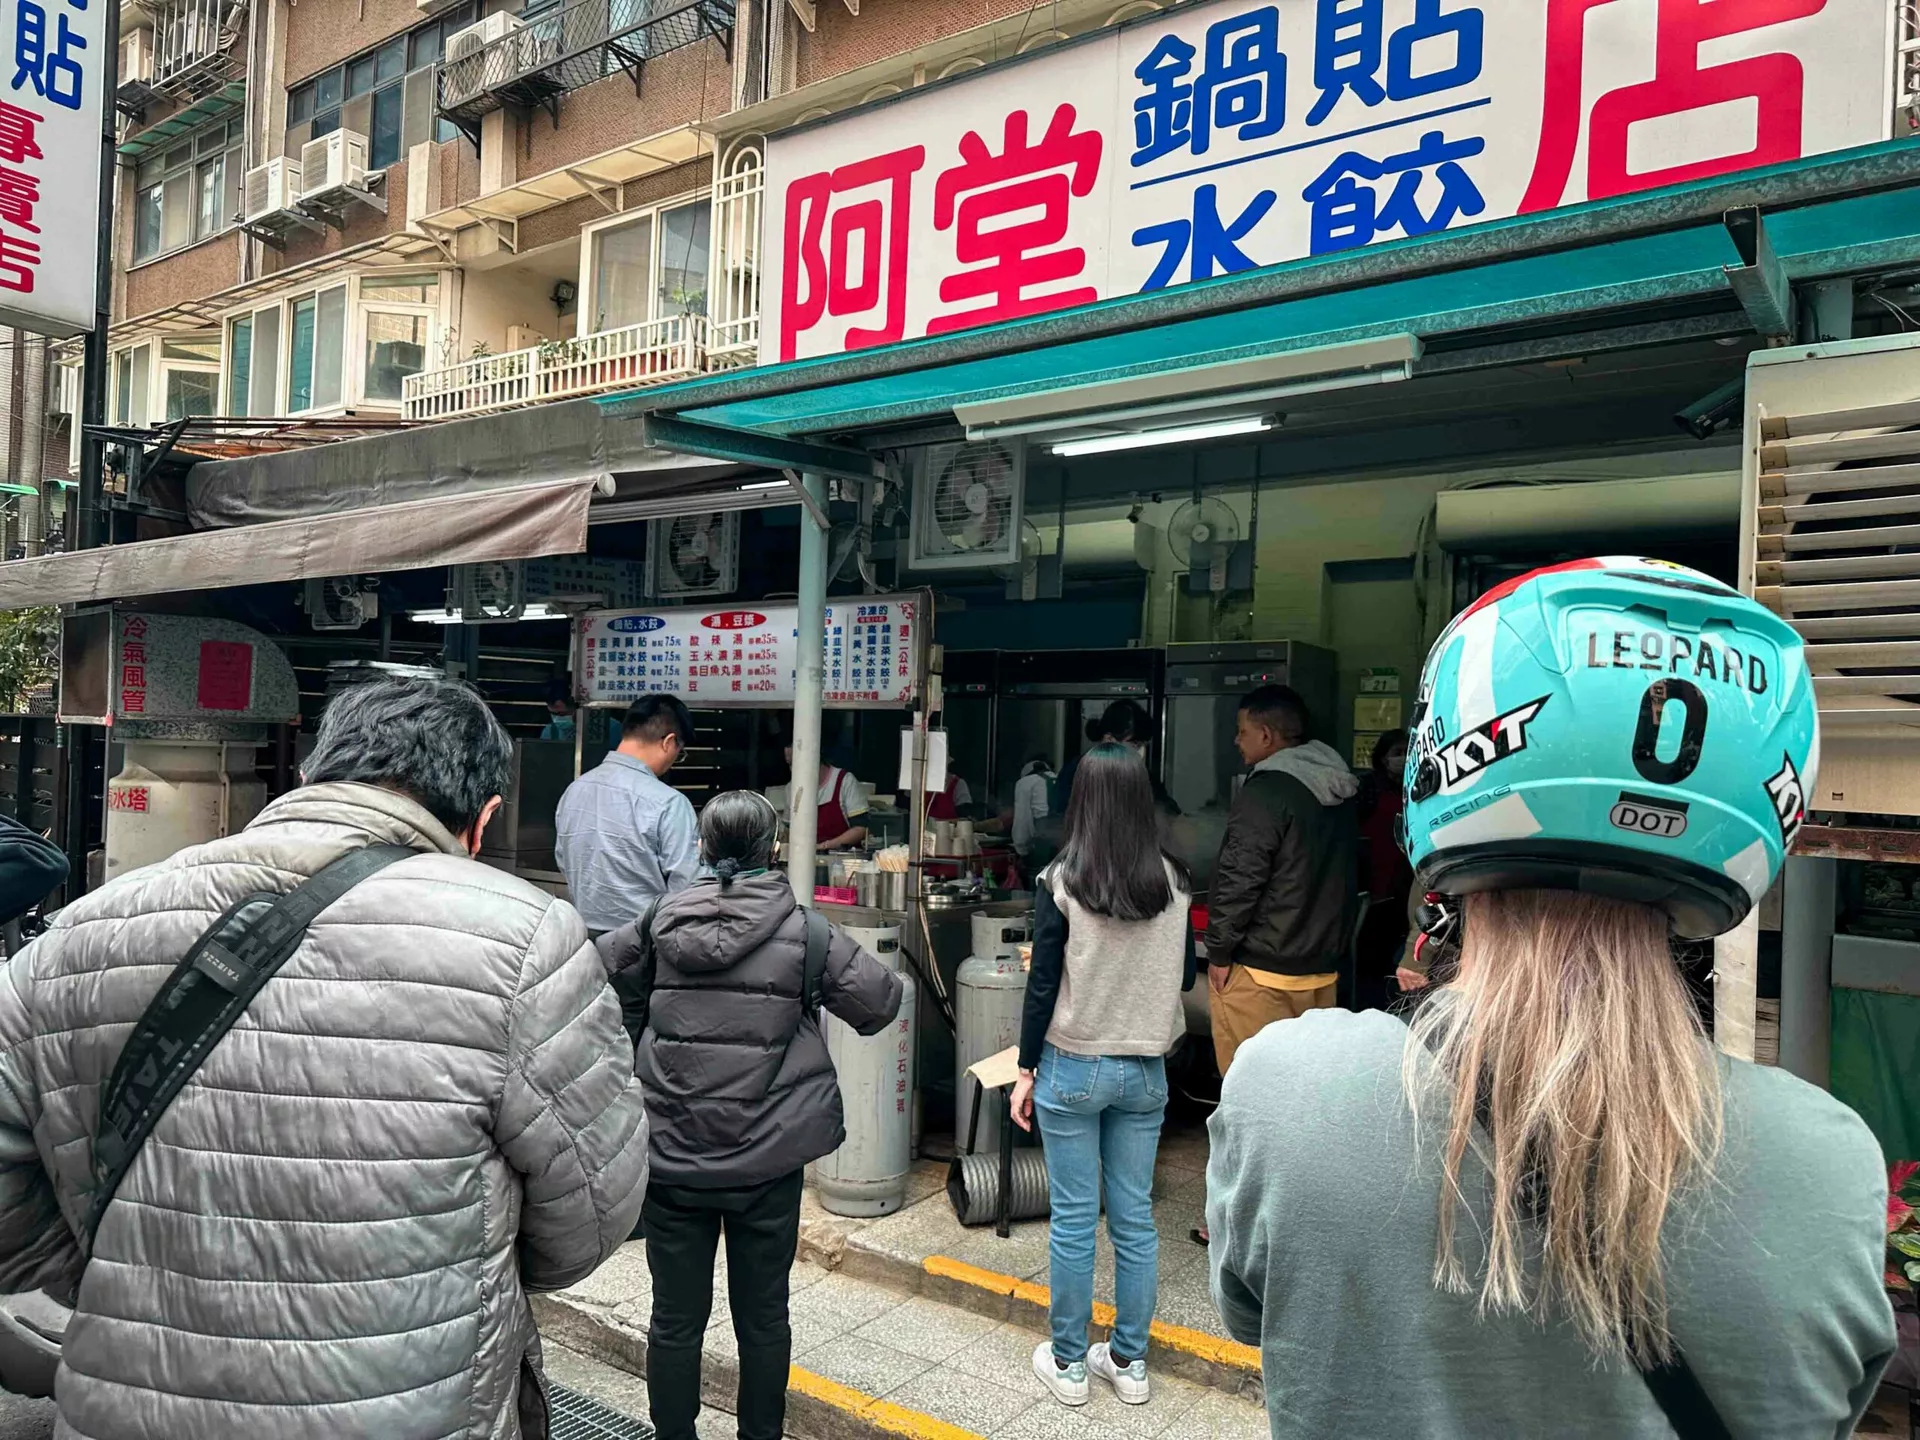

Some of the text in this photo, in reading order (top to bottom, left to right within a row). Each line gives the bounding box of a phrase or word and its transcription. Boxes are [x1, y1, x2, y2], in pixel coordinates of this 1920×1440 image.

[11, 0, 88, 110] 貼
[1130, 0, 1483, 168] 鍋貼
[780, 102, 1103, 363] 阿堂
[1131, 130, 1486, 293] 水餃
[121, 615, 148, 713] 冷氣風管
[1588, 630, 1768, 695] LEOPARD
[1438, 700, 1543, 784] KYT
[1631, 677, 1709, 785] 0
[107, 787, 149, 812] 水塔
[1617, 808, 1682, 835] DOT
